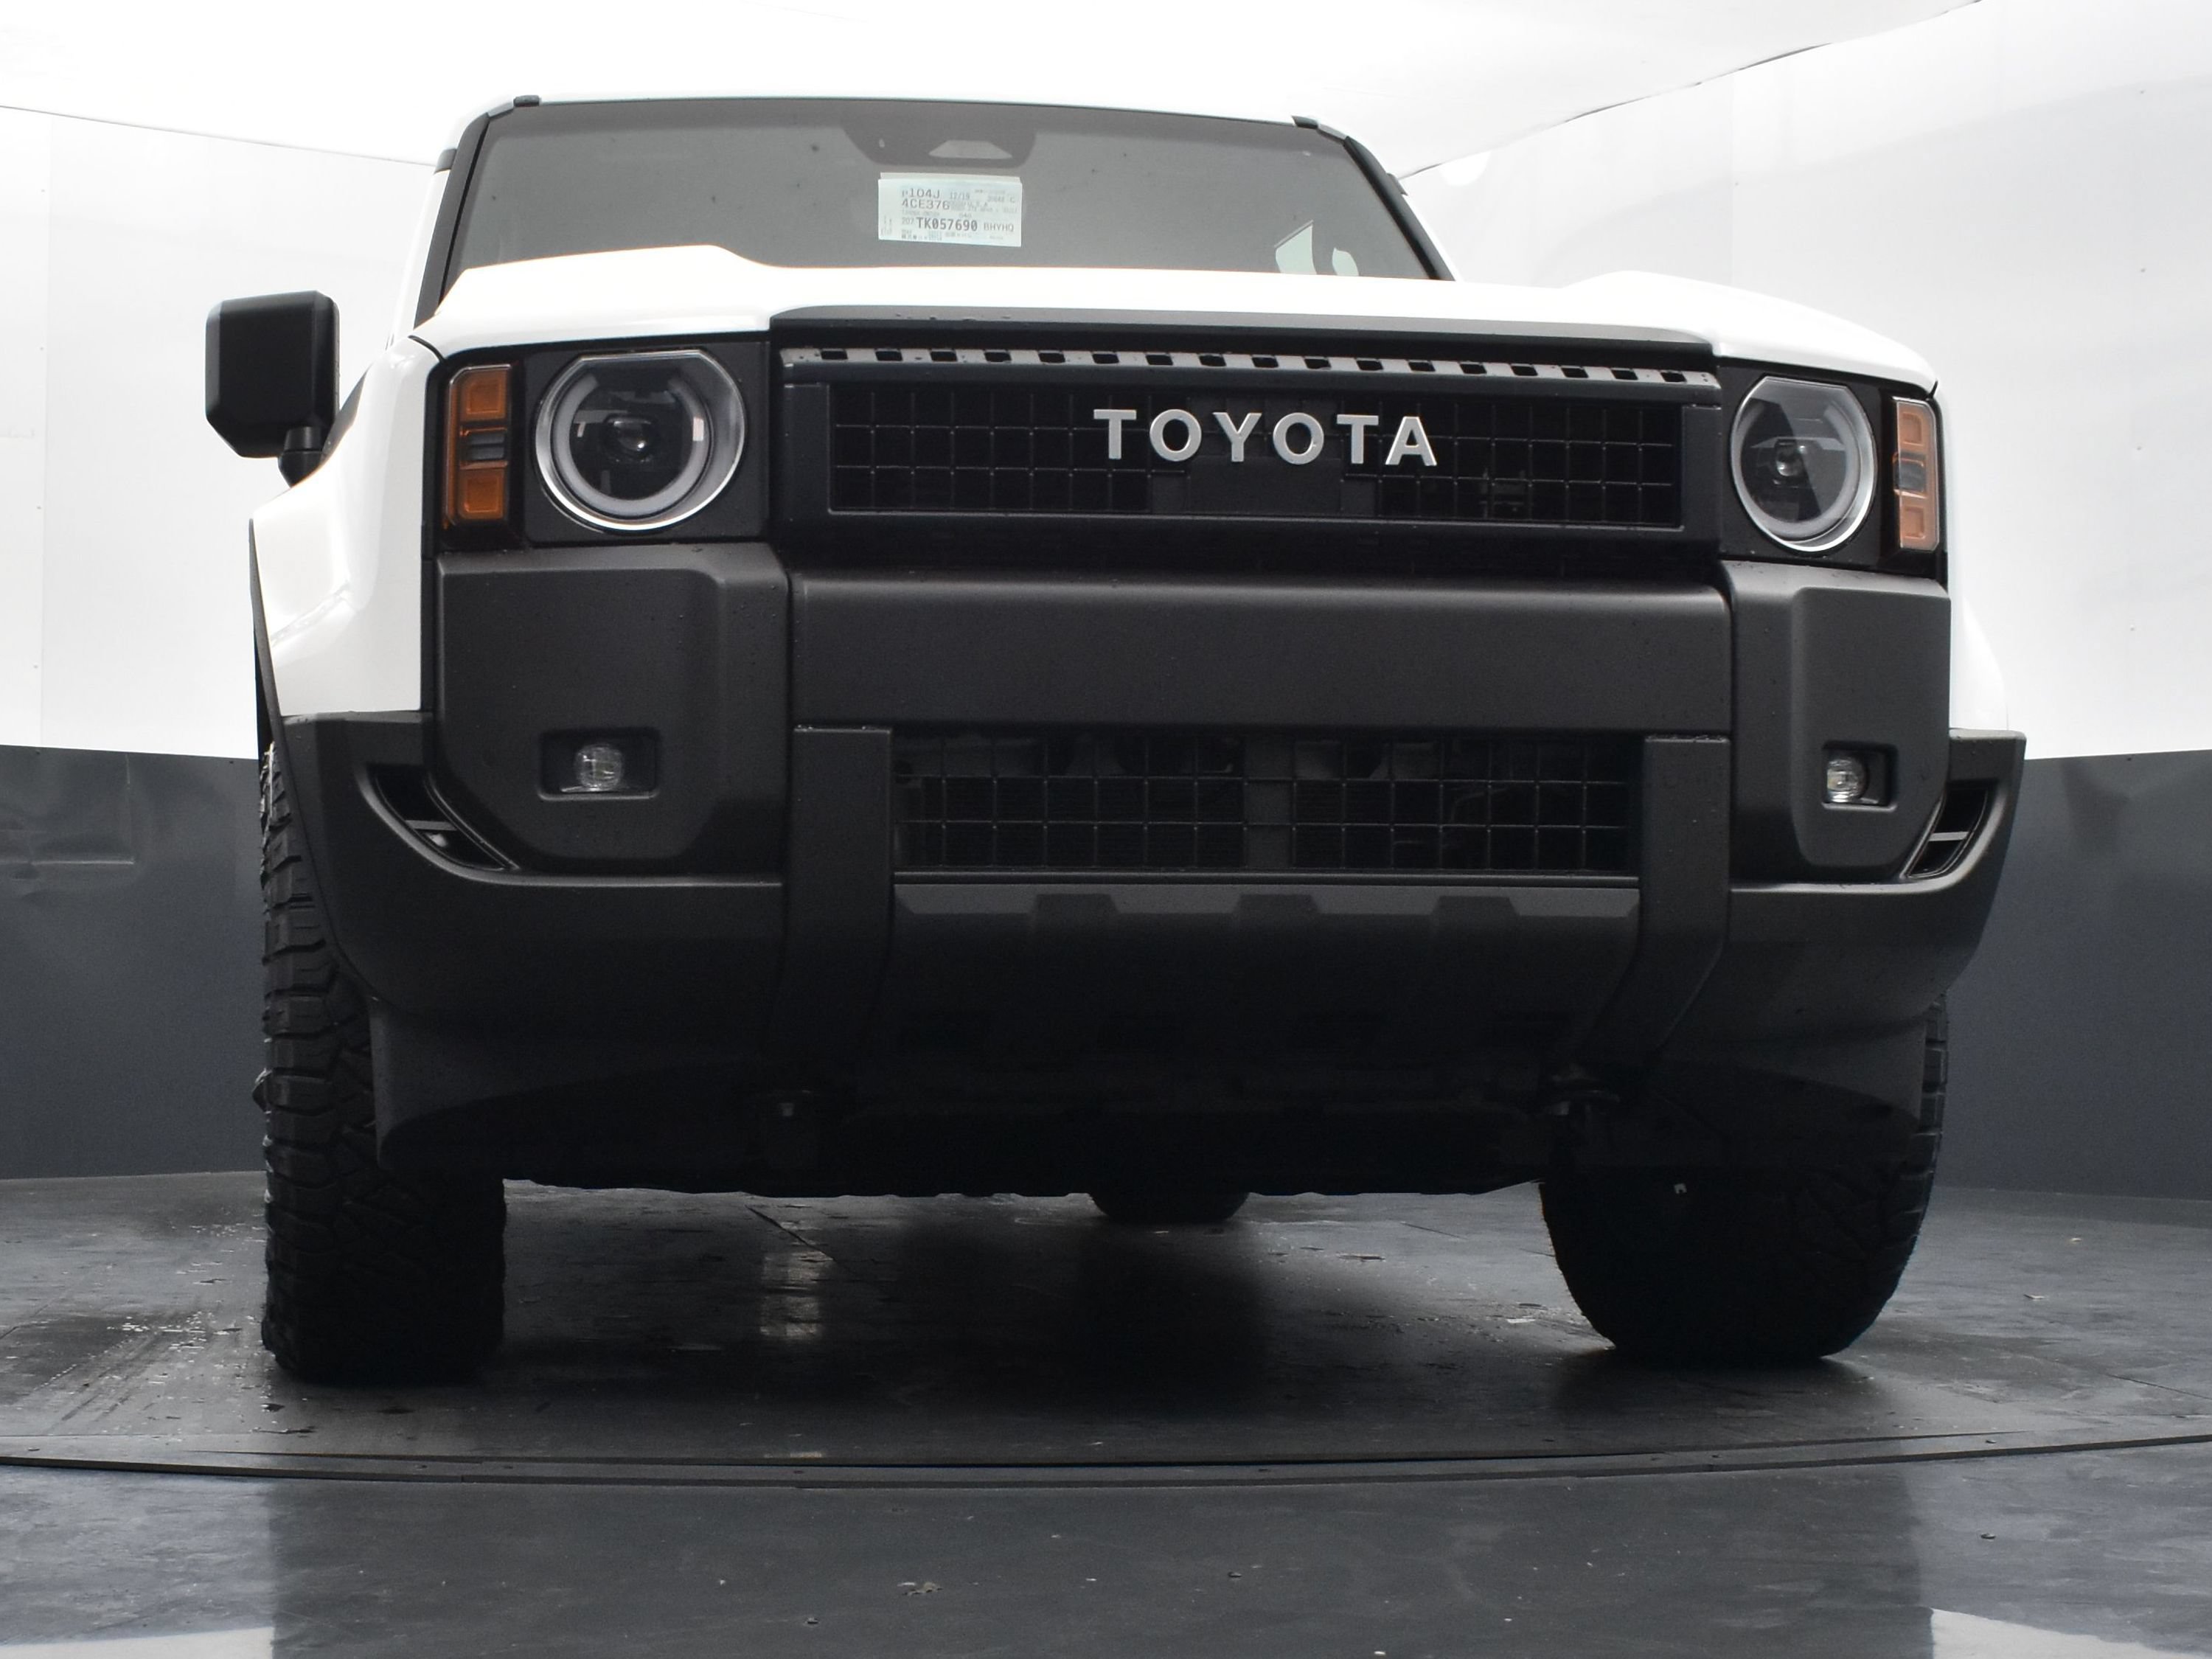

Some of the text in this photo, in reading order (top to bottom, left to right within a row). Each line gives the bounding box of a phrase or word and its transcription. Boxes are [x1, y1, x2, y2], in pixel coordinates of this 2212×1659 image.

[902, 198, 950, 210] 4CE376
[916, 217, 978, 232] TK057690
[1093, 408, 1437, 466] TOYOTA
